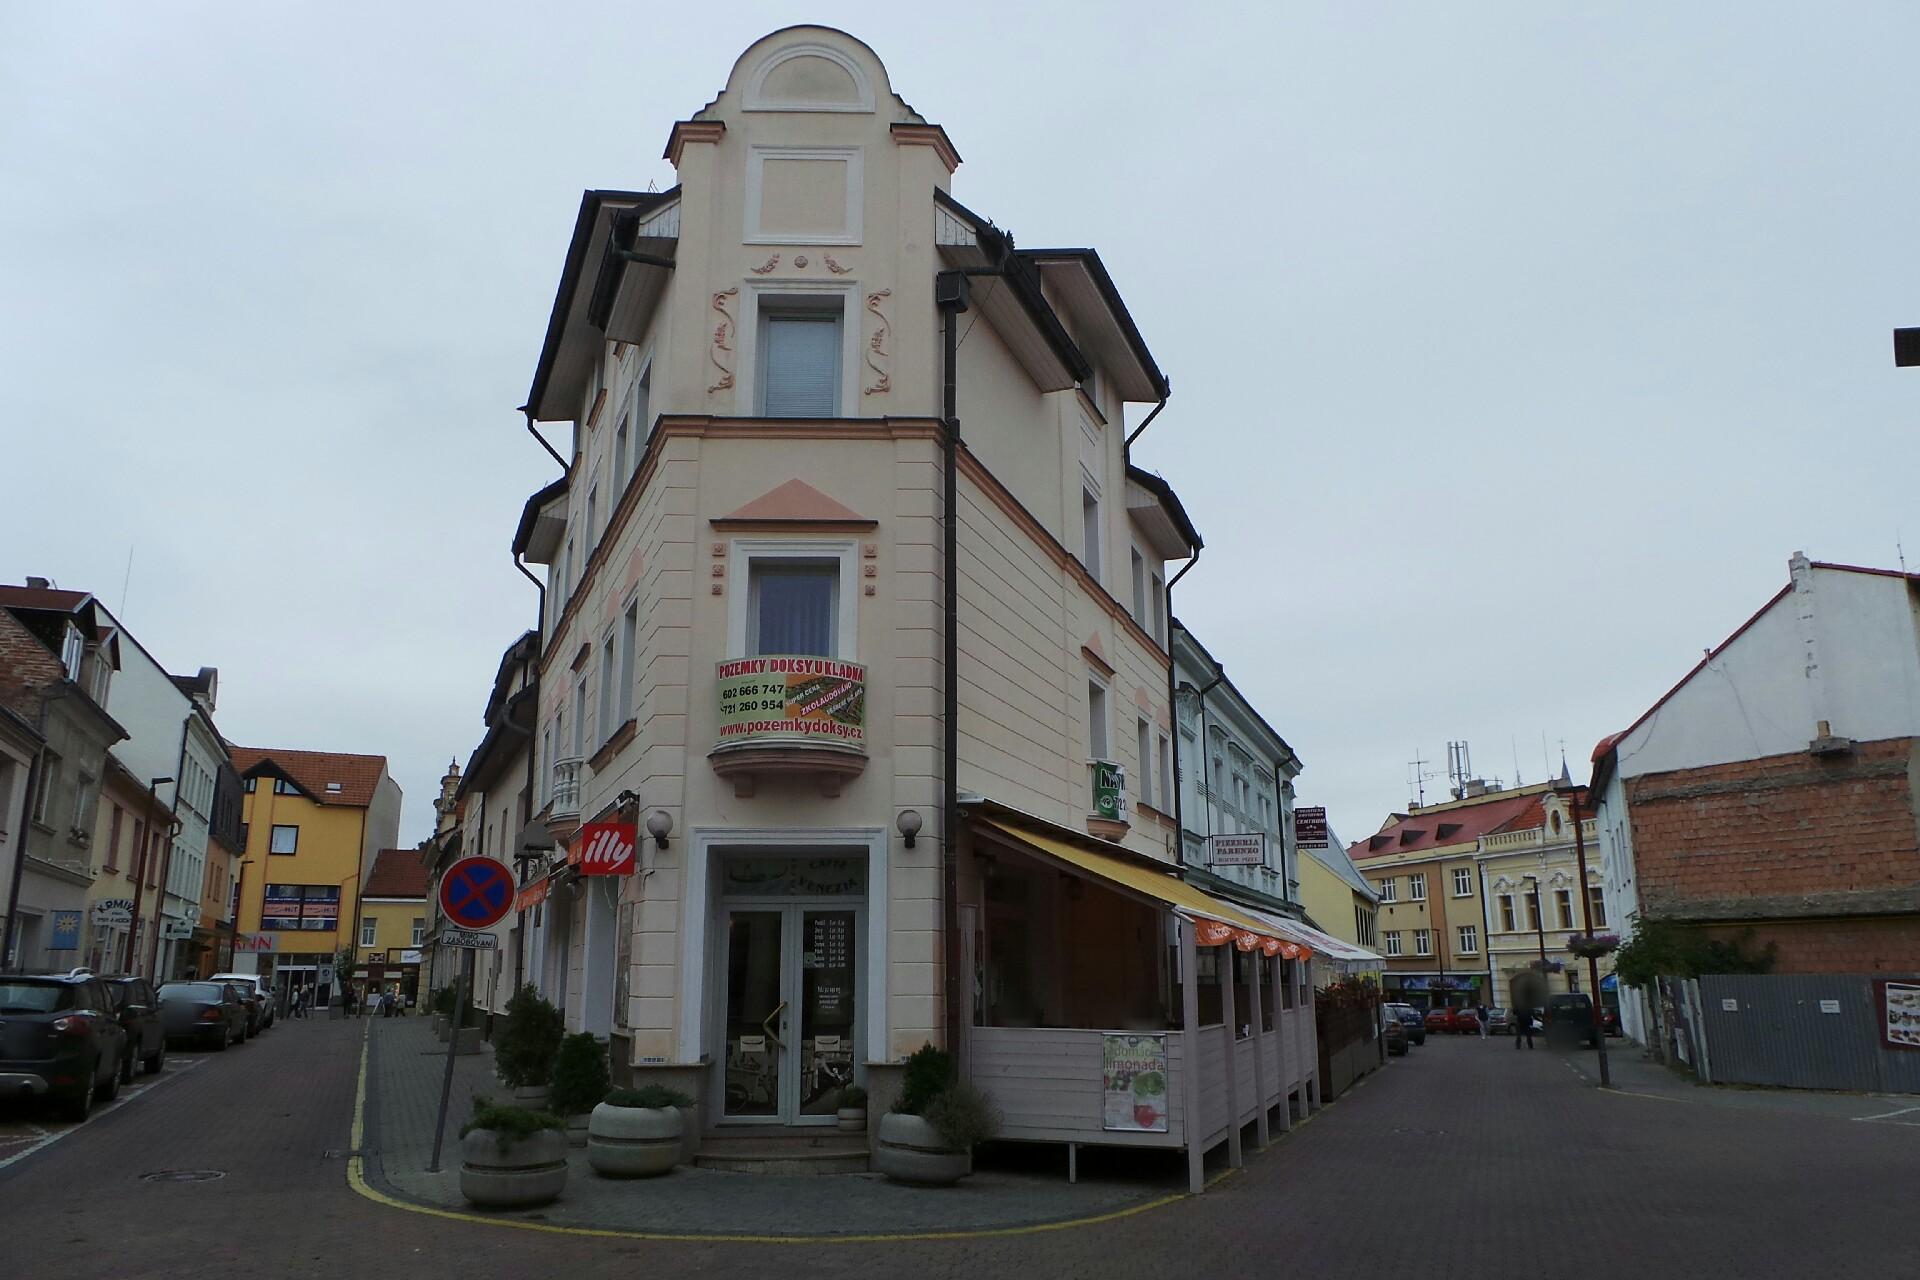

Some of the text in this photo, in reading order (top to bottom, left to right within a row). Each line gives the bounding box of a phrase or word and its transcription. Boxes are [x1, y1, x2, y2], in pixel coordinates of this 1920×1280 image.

[719, 658, 767, 679] POZEMKY
[770, 658, 814, 674] DOKSY
[823, 661, 863, 682] KLADNA
[723, 684, 784, 699] 602 666 747
[723, 700, 783, 716] 721 260 954
[720, 718, 862, 739] www.pozemkydoksy.cz
[584, 830, 633, 870] illy
[1215, 839, 1259, 847] PIZZERIA
[1217, 847, 1259, 855] PARENZO
